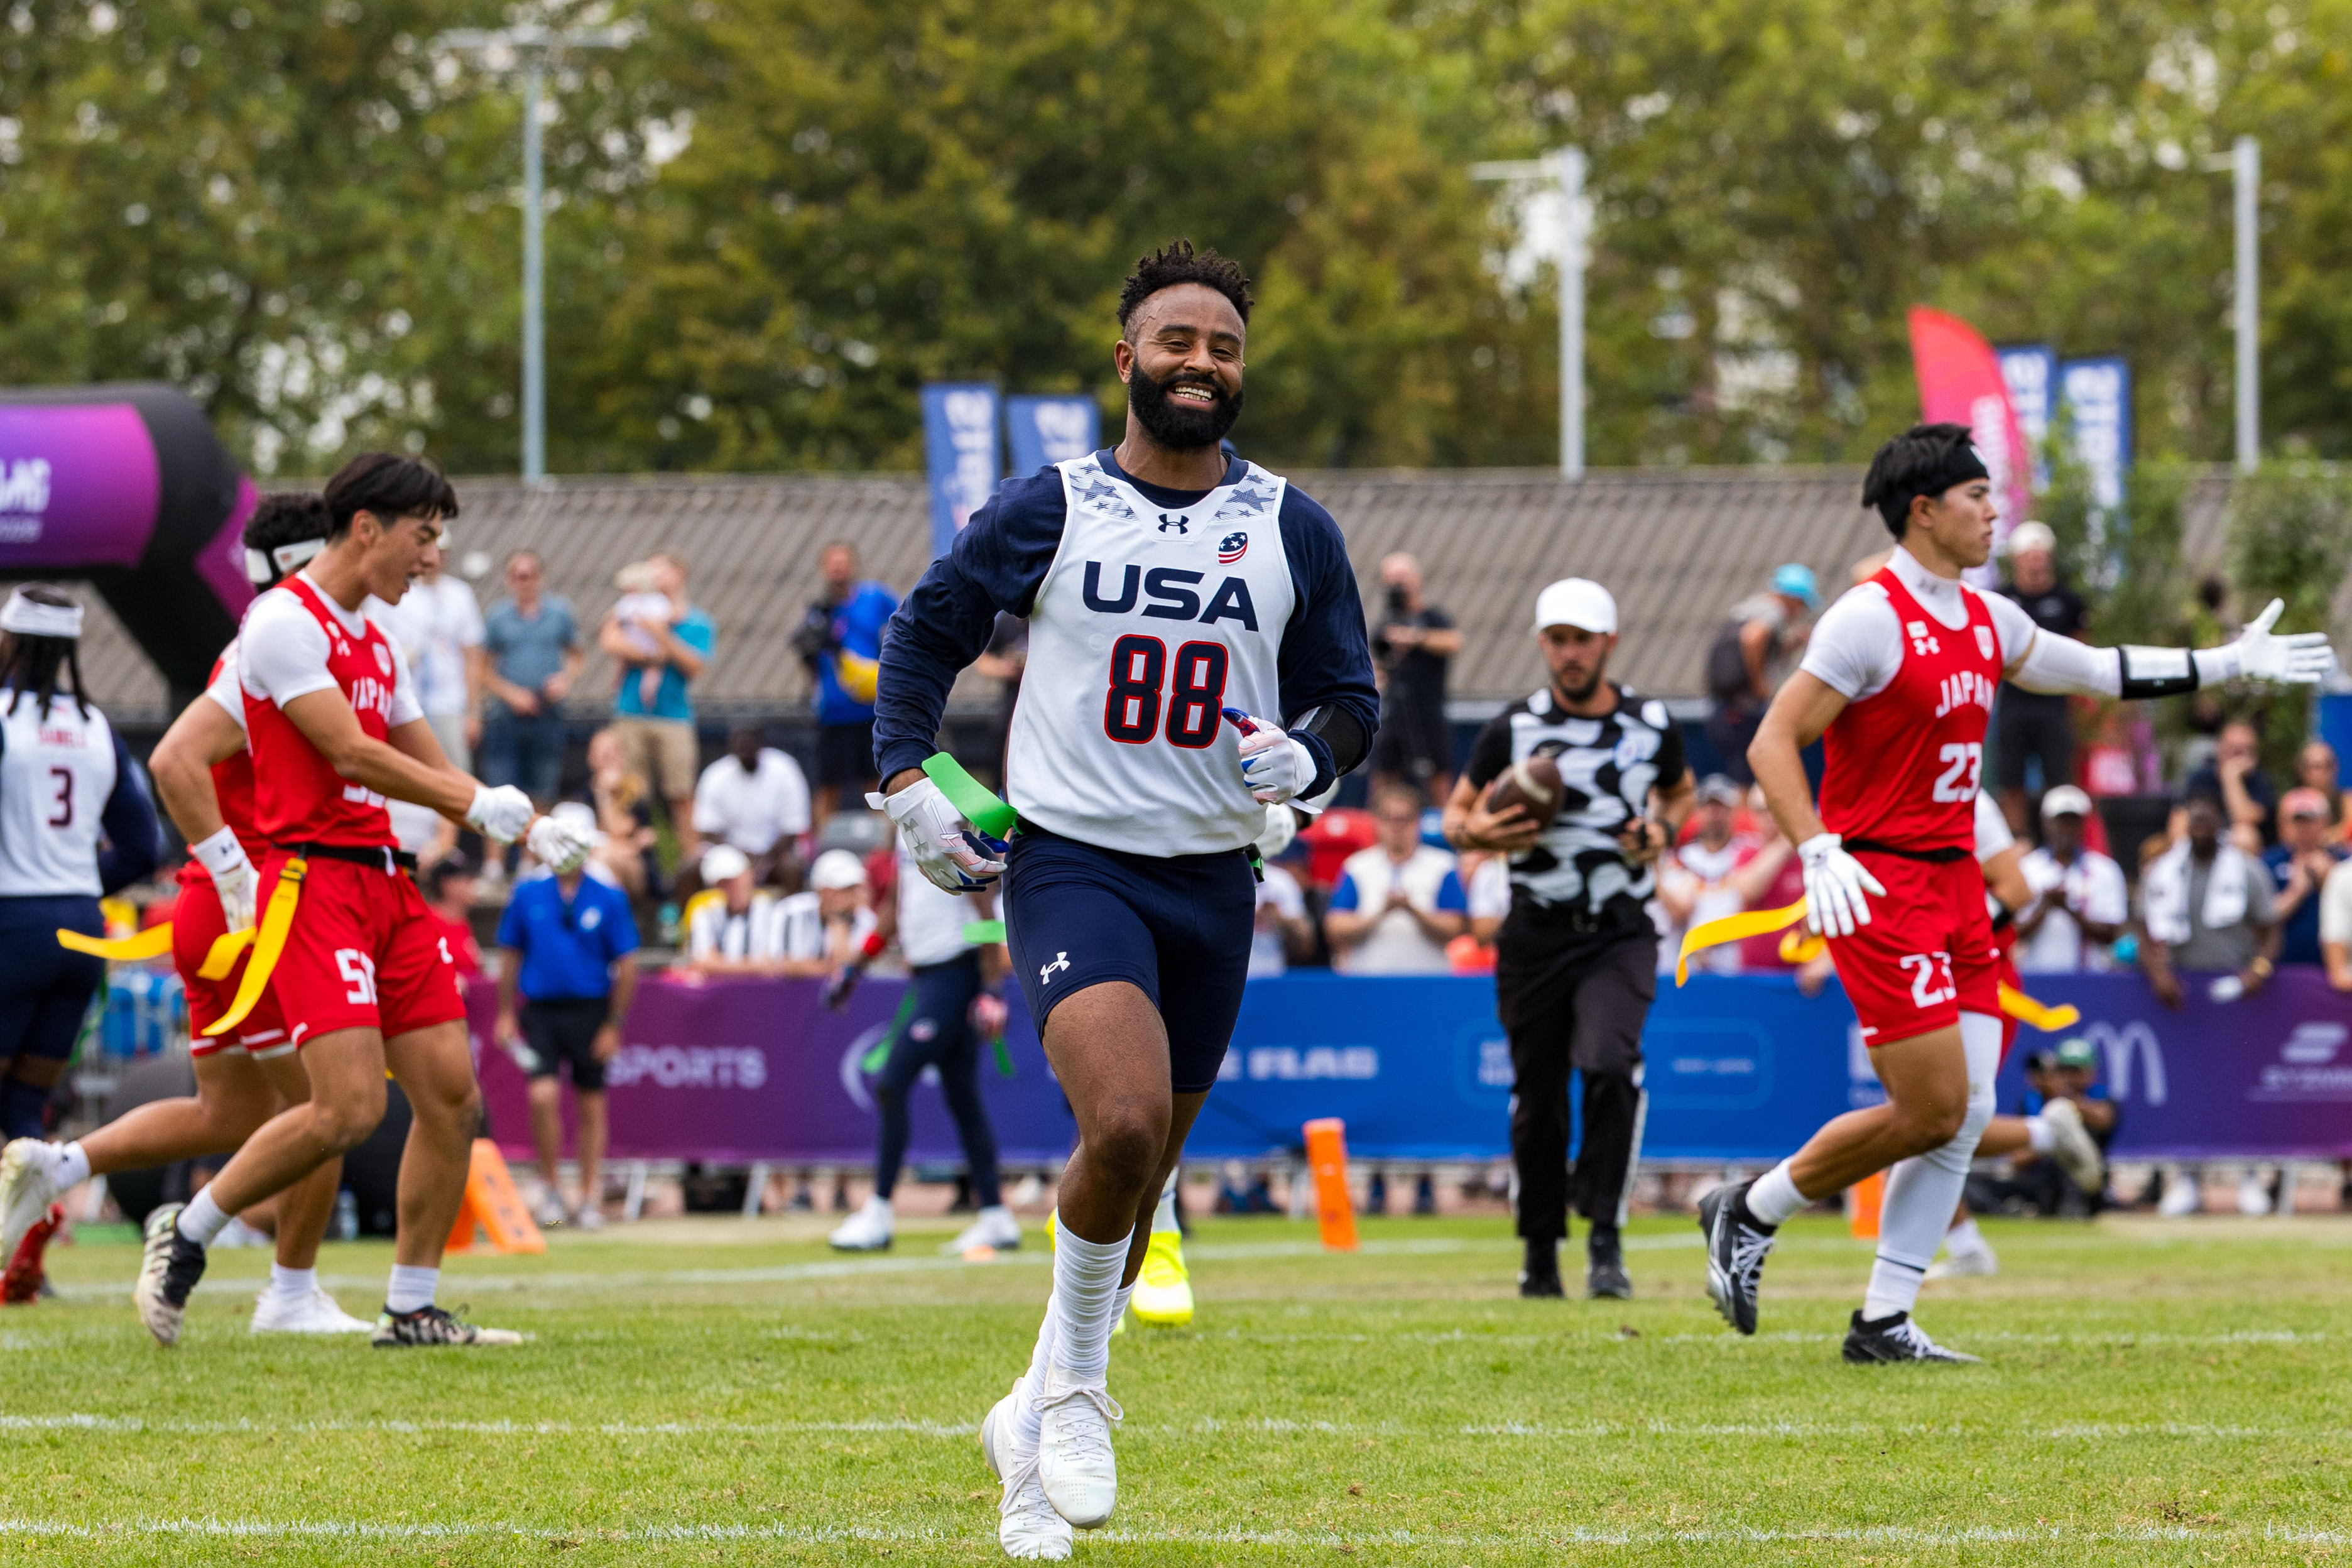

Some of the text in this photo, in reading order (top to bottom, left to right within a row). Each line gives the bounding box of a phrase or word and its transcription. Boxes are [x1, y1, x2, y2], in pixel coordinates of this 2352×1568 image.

[1082, 560, 1260, 633] USA
[1104, 633, 1229, 749] 88
[48, 766, 74, 829] 3
[1932, 741, 1983, 803] 23
